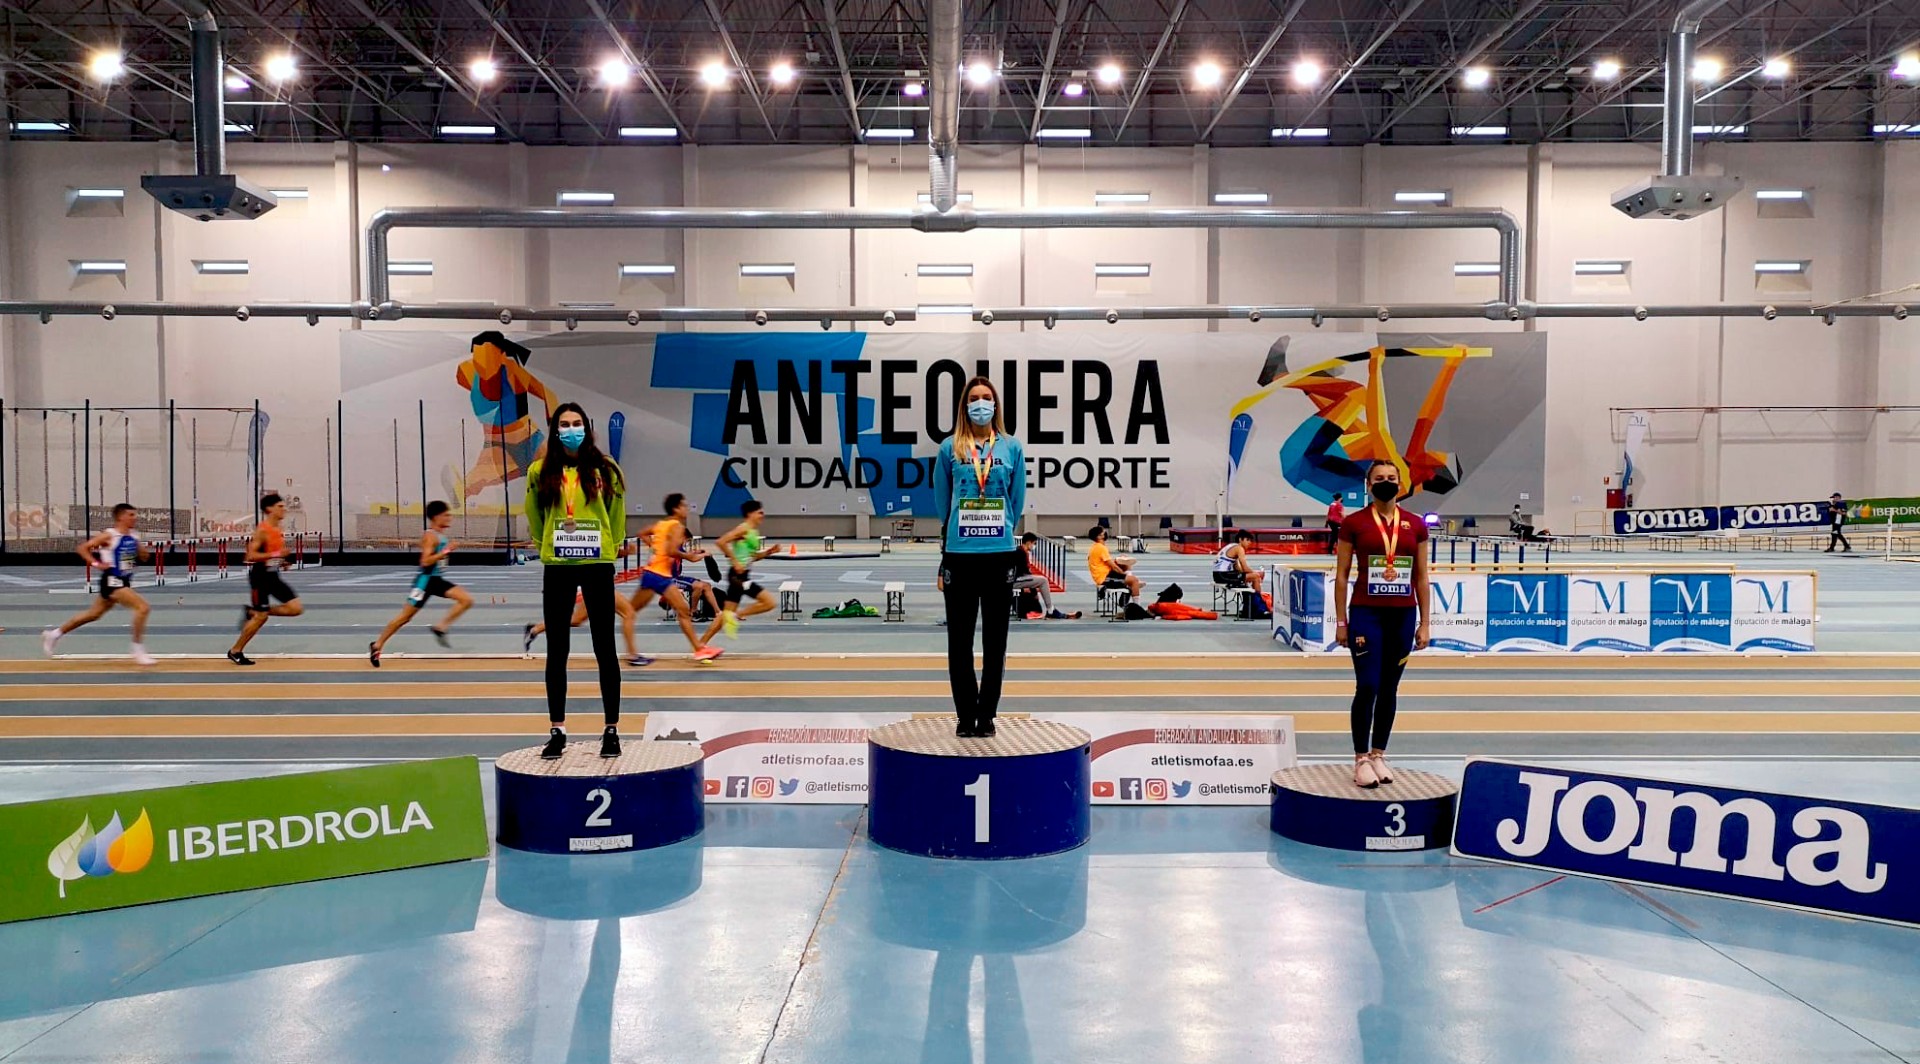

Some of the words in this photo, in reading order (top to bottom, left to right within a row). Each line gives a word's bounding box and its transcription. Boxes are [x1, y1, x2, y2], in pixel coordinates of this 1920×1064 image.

[722, 360, 1170, 444] ANTEQUERA
[721, 457, 883, 489] CIUDAD
[961, 513, 990, 521] ANTEQUERA
[1623, 507, 1709, 533] Joma
[1730, 503, 1822, 529] Joma
[1446, 617, 1454, 625] de
[1489, 618, 1525, 626] diputación
[1526, 617, 1535, 625] de
[1536, 617, 1566, 626] málaga
[1571, 618, 1606, 626] diputación
[1608, 617, 1617, 625] de
[1618, 617, 1648, 626] málaga
[1652, 617, 1689, 627] diputación
[1690, 617, 1700, 626] de
[1700, 617, 1730, 627] málaga
[1734, 617, 1771, 626] diputación
[1772, 617, 1780, 625] de
[1781, 617, 1811, 626] málaga
[768, 725, 811, 743] FEDERACIÓN
[812, 729, 851, 743] ANDALUZA
[851, 729, 862, 743] DE
[1154, 725, 1197, 744] FEDERACIÓN
[1198, 729, 1235, 744] ANDALUZA
[1236, 729, 1246, 744] DE
[761, 753, 865, 766] atletismofaa.es
[1151, 755, 1254, 767] atletismofaa.es
[585, 788, 612, 827] 2
[964, 774, 990, 843] 1
[1384, 803, 1406, 837] 3
[168, 801, 434, 863] IBERDROLA
[1496, 771, 1887, 893] Joma
